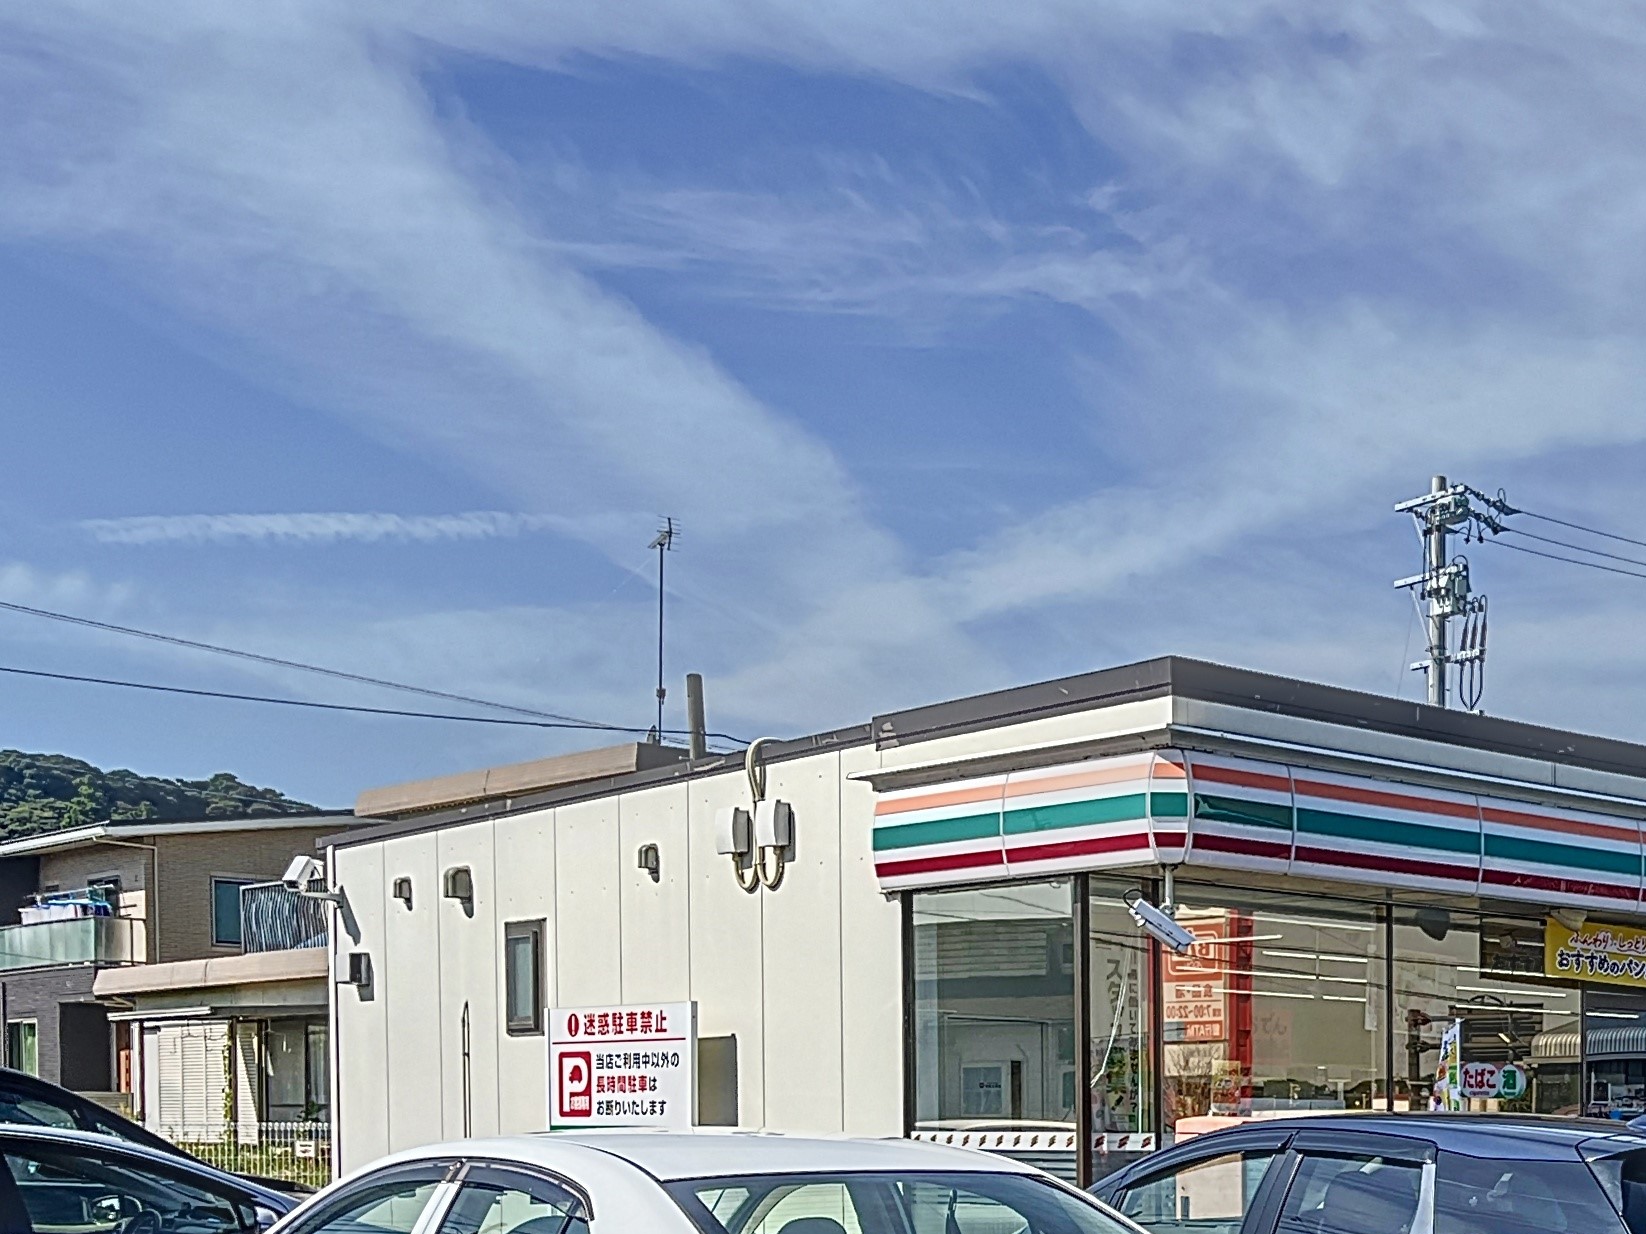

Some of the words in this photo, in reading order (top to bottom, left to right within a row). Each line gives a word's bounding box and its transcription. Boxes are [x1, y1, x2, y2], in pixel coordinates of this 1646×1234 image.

[583, 1009, 668, 1036] 迷惑駐車禁止
[595, 1051, 680, 1070] 当店ご利用中以外の
[596, 1075, 658, 1094] 長時間駐車は
[1463, 1068, 1496, 1089] たばこ
[596, 1099, 667, 1116] お断りいたします
